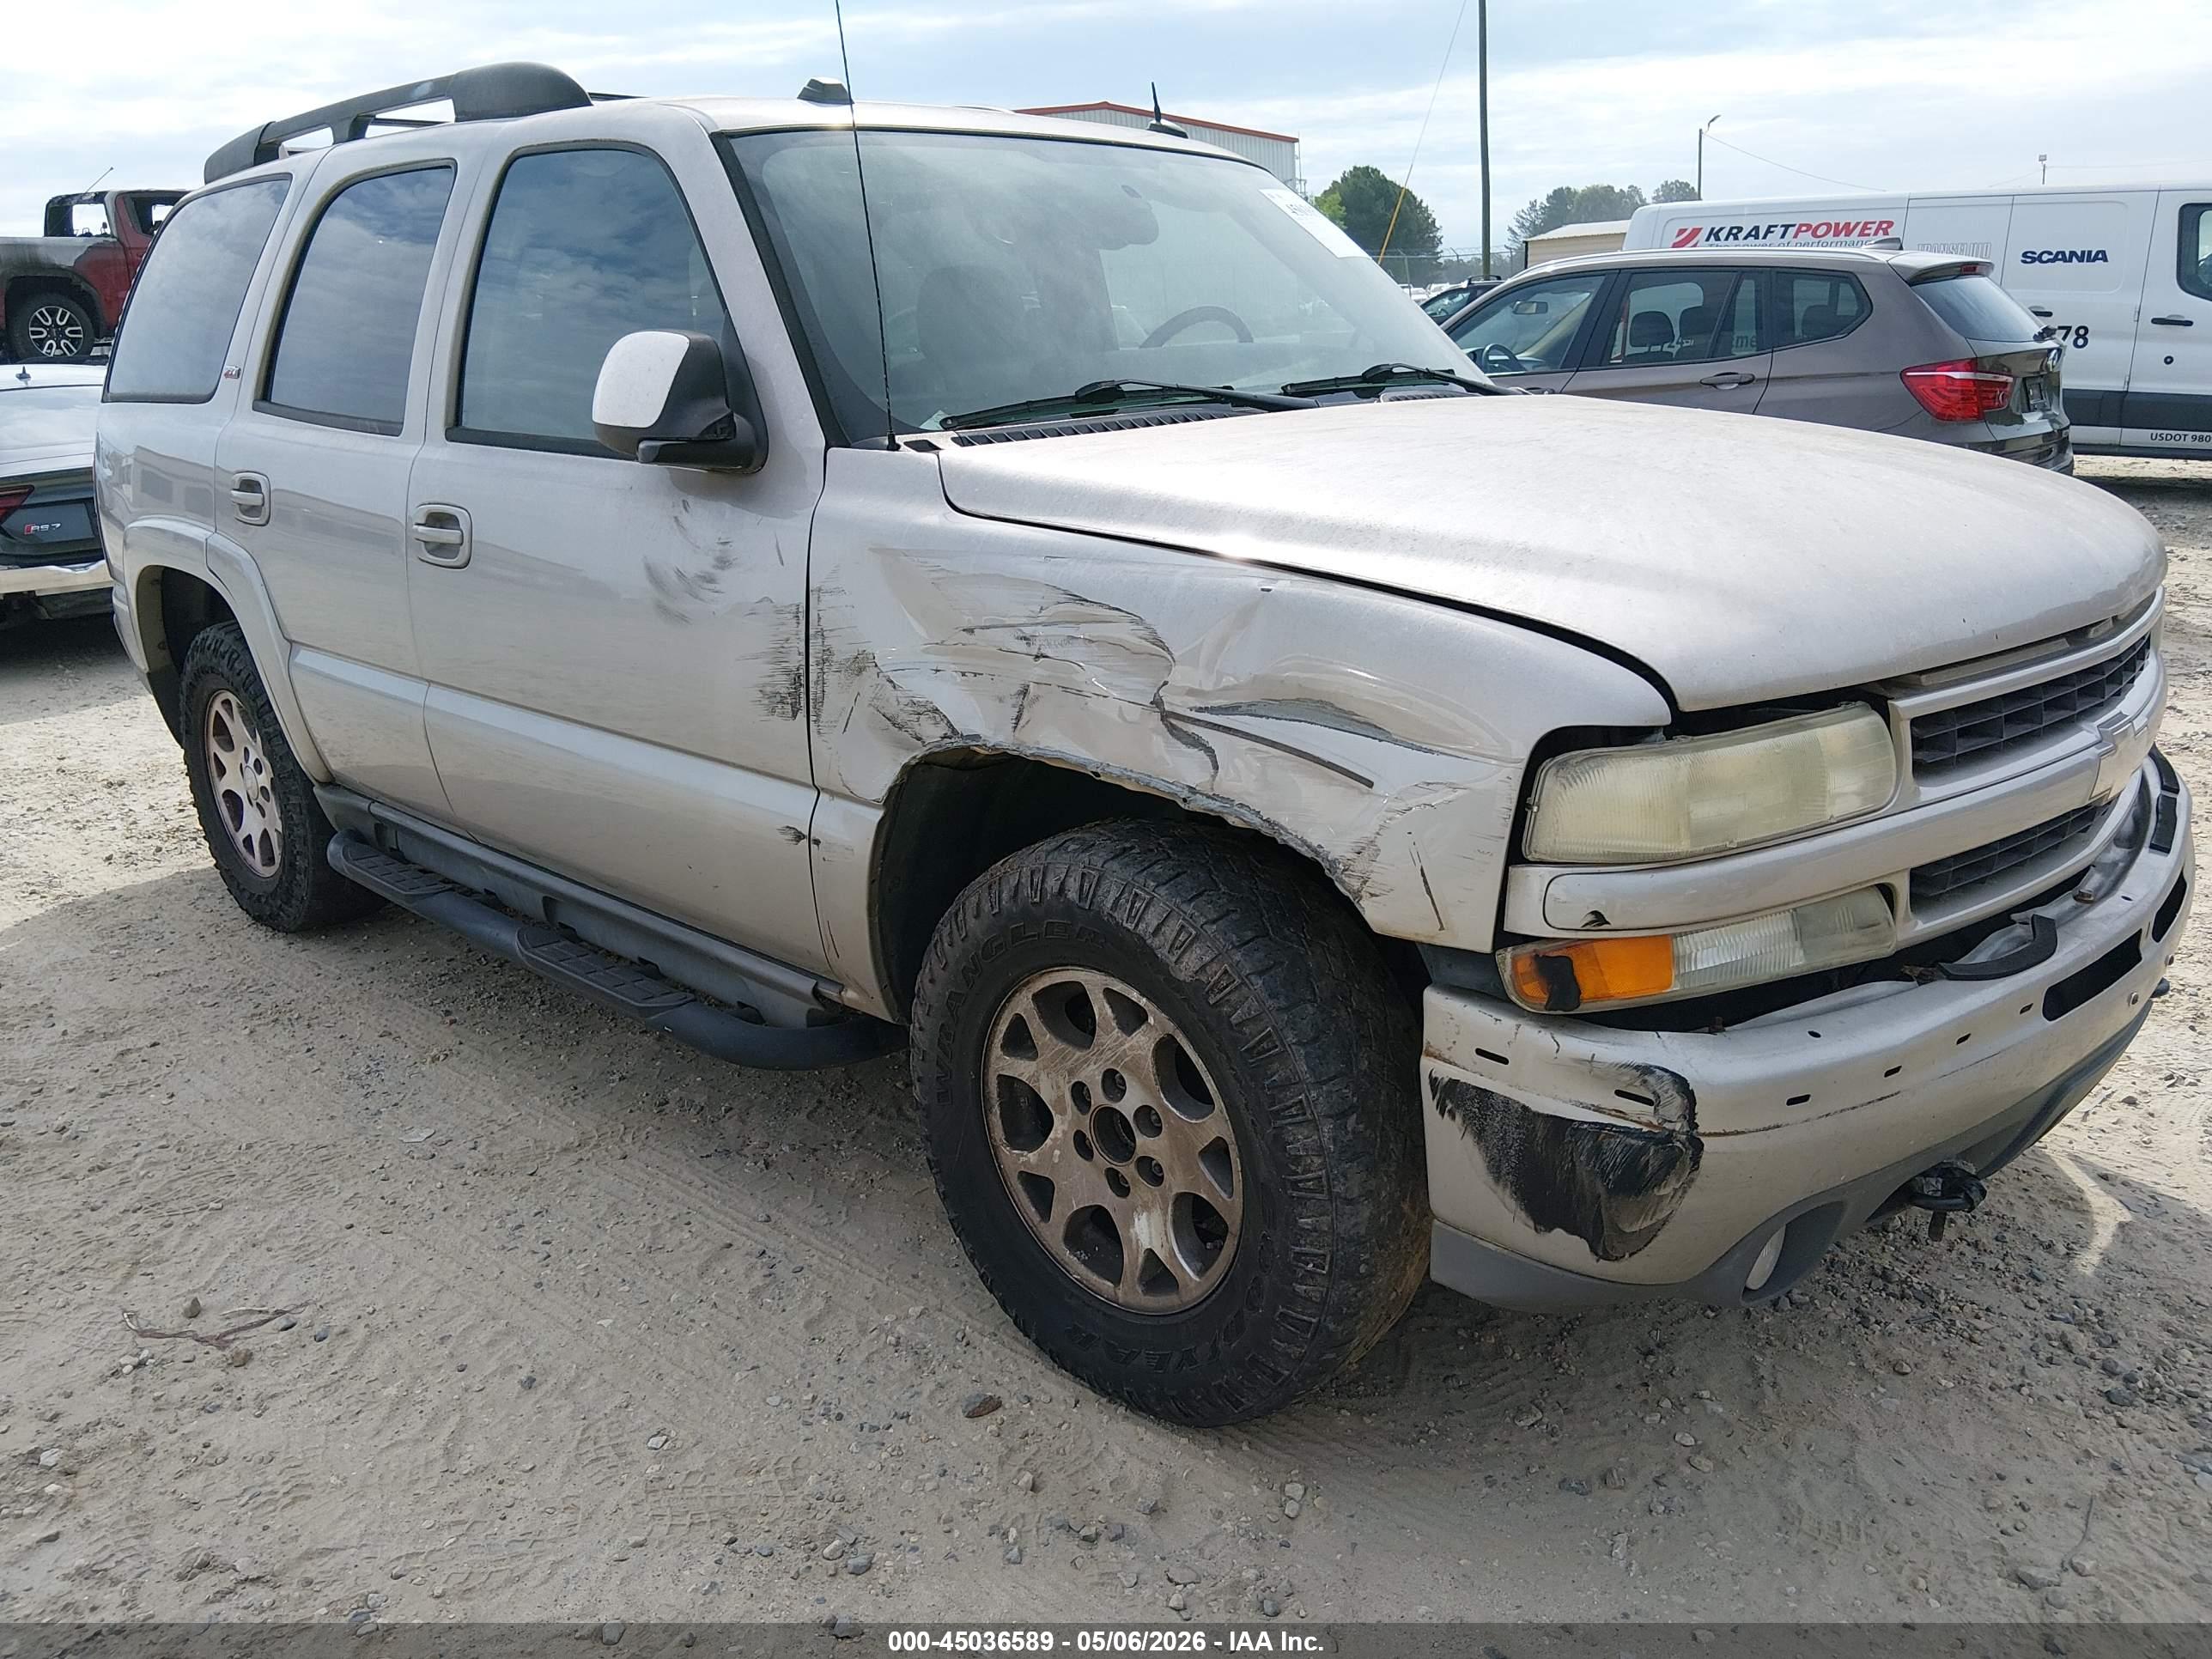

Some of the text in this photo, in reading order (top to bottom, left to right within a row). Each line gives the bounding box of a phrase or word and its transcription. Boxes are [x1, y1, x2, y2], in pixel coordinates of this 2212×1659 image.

[1705, 220, 1894, 242] KRAFTPOWER
[2021, 250, 2109, 264] SCANIA
[2150, 432, 2211, 443] USDOT 980
